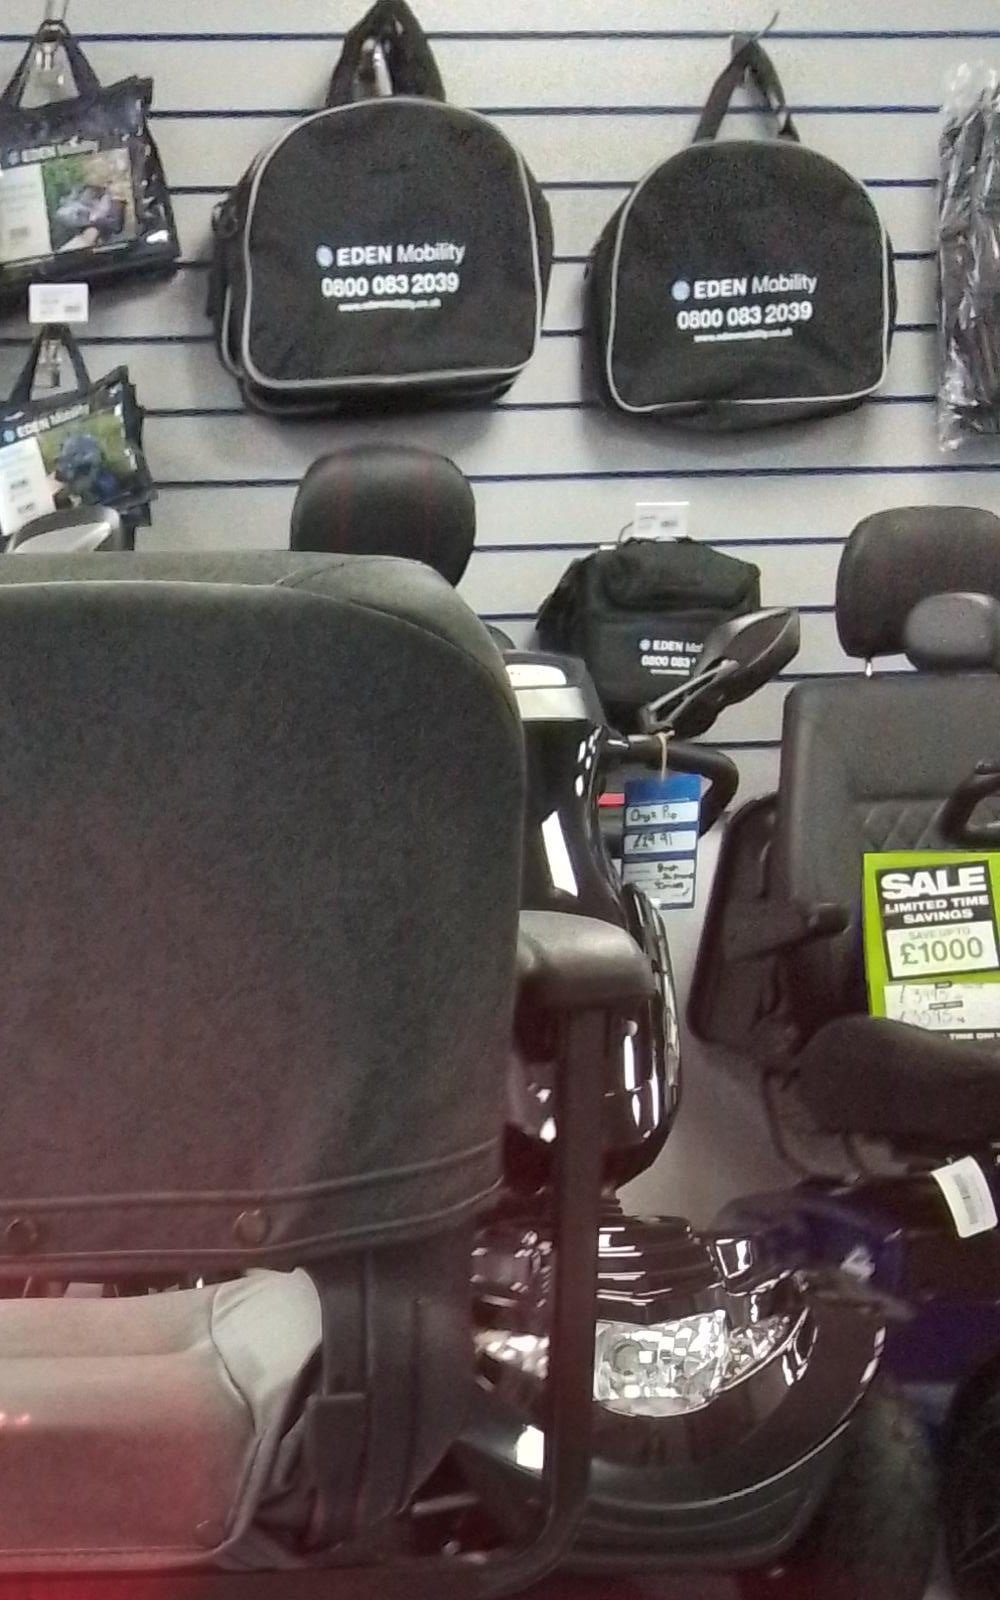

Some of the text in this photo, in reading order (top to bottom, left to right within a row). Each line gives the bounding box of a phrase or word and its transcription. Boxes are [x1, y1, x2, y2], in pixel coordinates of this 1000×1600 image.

[336, 243, 466, 267] EDEN Mobility
[321, 272, 459, 297] 0800 083 2039
[693, 274, 817, 299] EDEN Mobility
[677, 301, 813, 330] 0800 083 2039
[653, 640, 683, 652] EDEN
[880, 866, 987, 900] SALE
[885, 894, 989, 914] LIMITED TIME
[903, 908, 974, 924] SAVINGS
[900, 936, 984, 965] £1000
